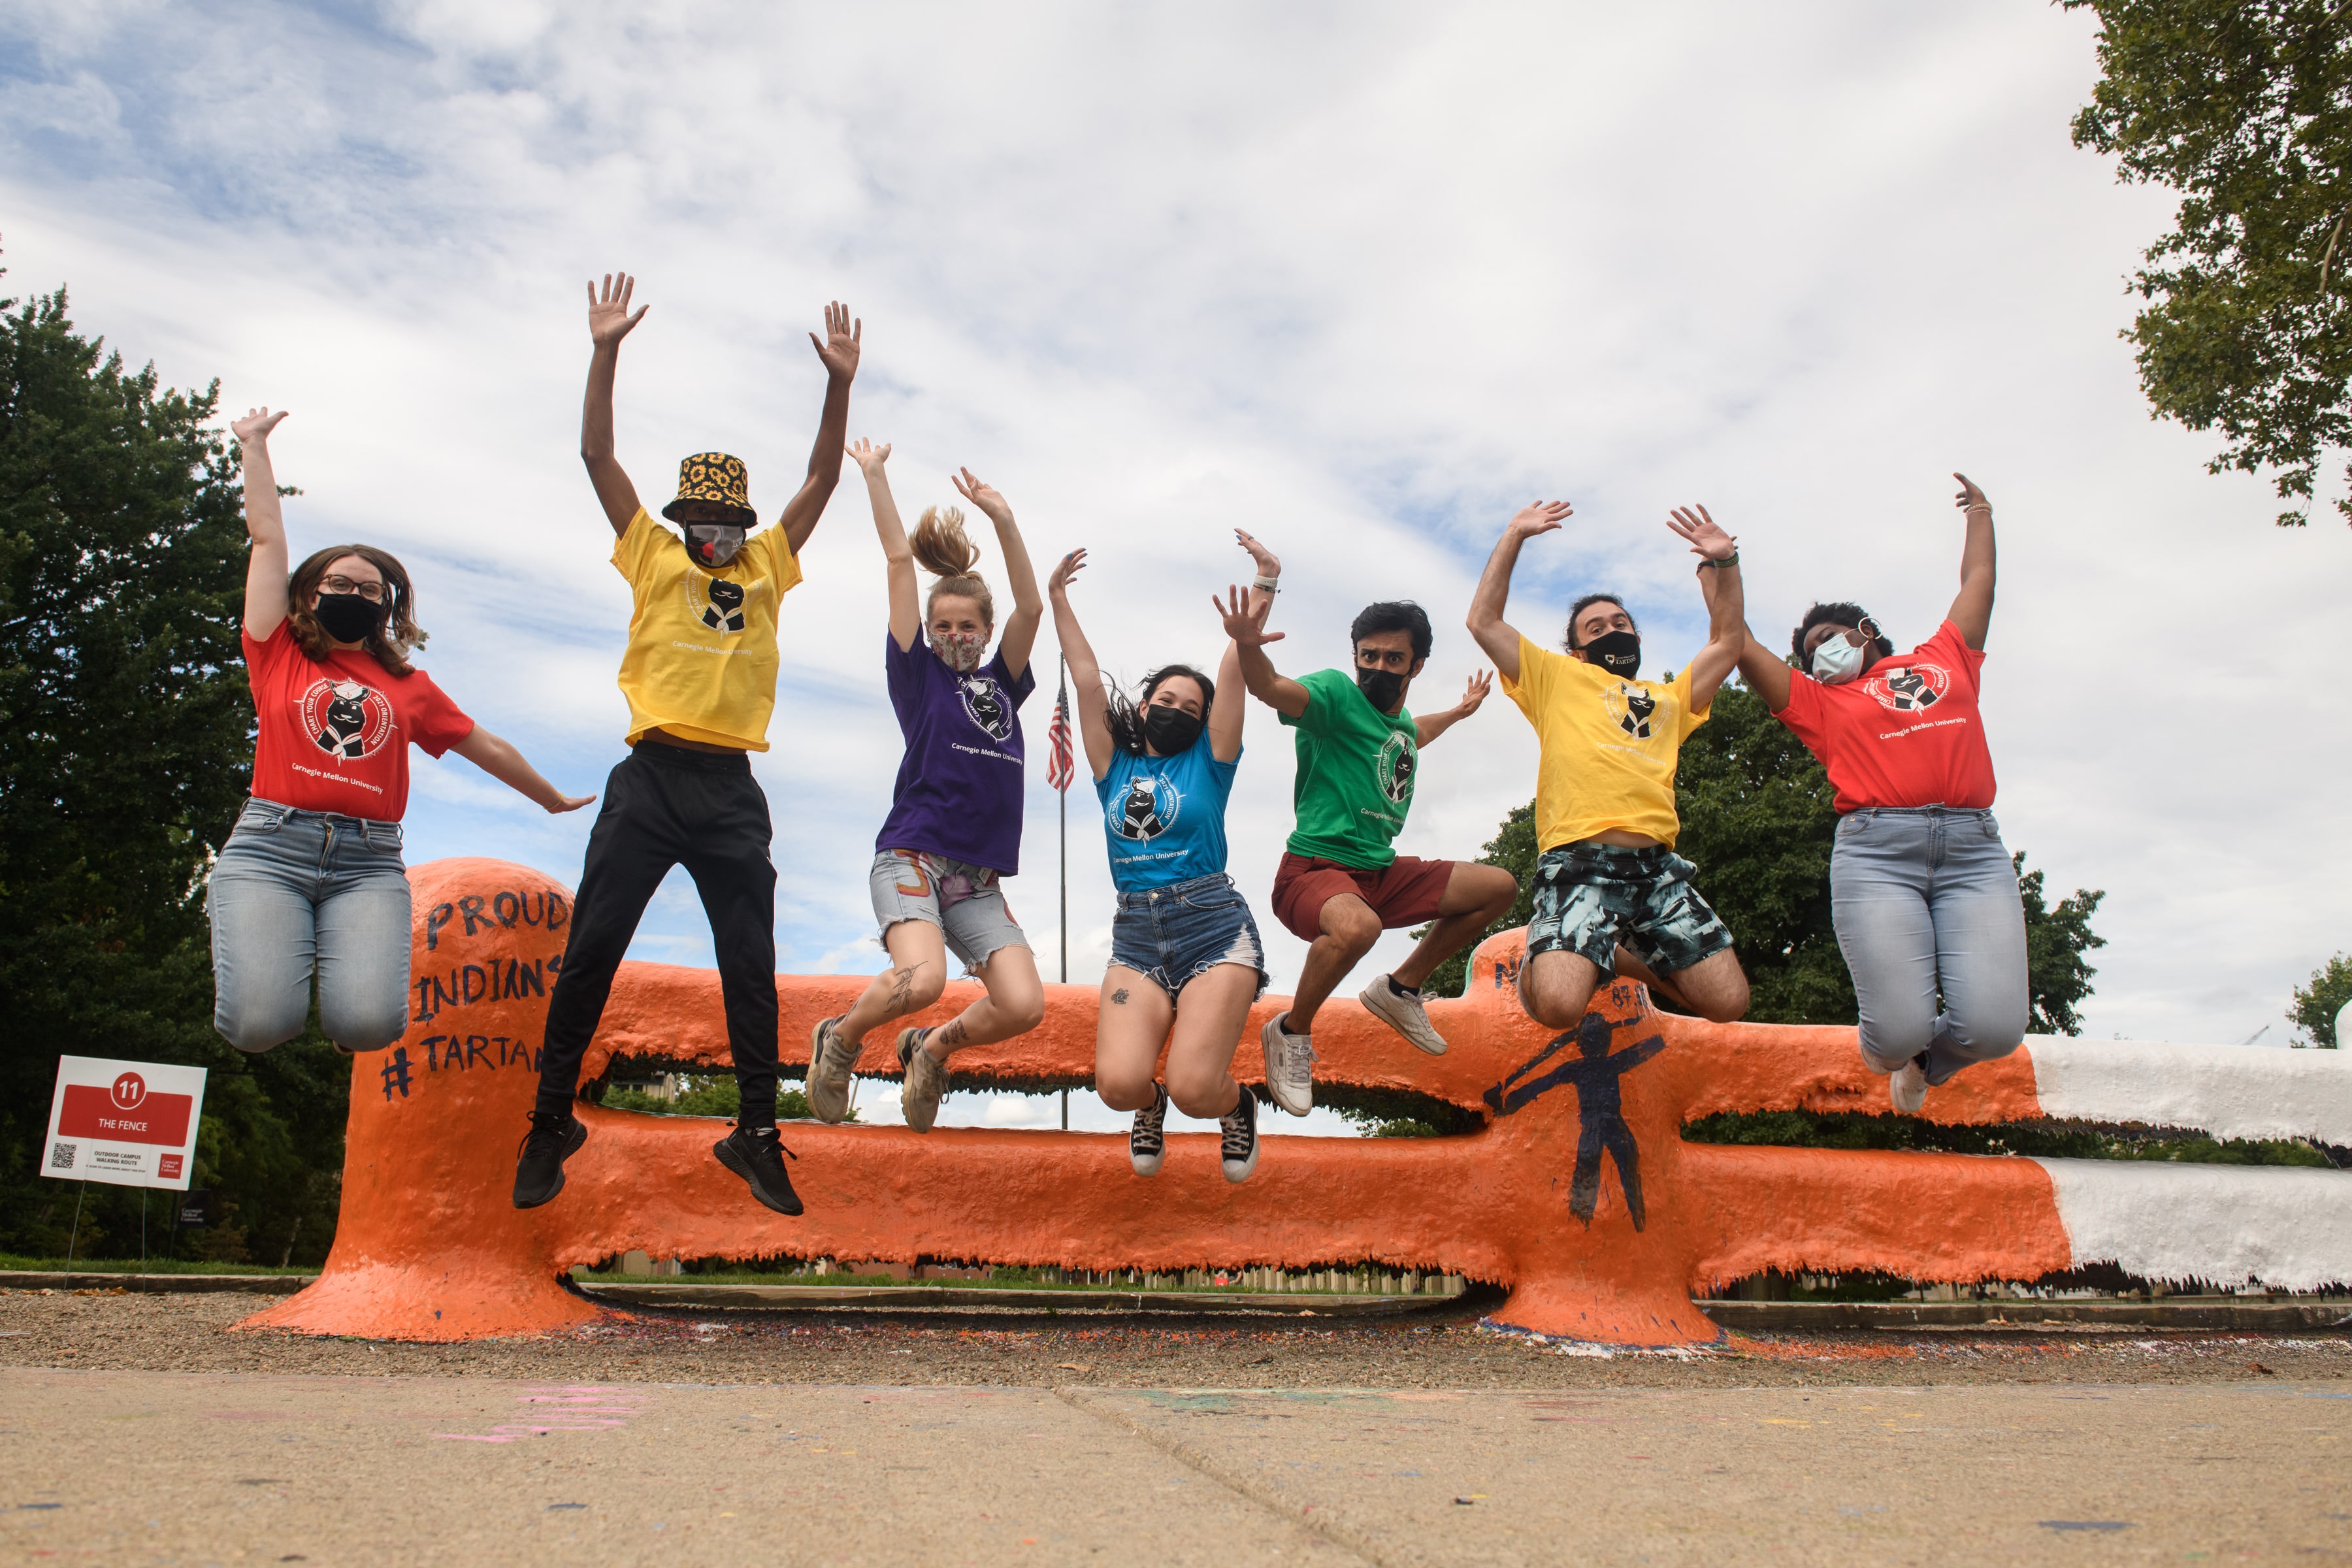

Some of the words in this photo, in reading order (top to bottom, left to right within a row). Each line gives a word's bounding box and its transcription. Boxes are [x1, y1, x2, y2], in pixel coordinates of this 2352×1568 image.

[692, 595, 703, 613] CHART
[673, 640, 703, 651] Carnegie
[705, 646, 727, 655] Mellon
[311, 683, 329, 697] COURSE
[306, 697, 315, 713] YOUR
[372, 695, 384, 708] 2021
[308, 716, 319, 734] CHART
[371, 708, 387, 746] ORIENTATION
[1880, 726, 1910, 740] Carnegie
[1910, 720, 1934, 732] Mellon
[1935, 717, 1966, 727] University
[1385, 738, 1397, 752] COURS
[1596, 742, 1624, 751] Carnegie
[1625, 746, 1642, 757] Mellon
[951, 743, 979, 754] Carnegie
[981, 749, 1001, 759] Mellon
[1002, 753, 1023, 766] University
[291, 762, 321, 777] Carnegie
[323, 772, 349, 783] Mellon
[350, 777, 384, 795] University
[1159, 778, 1169, 789] 2021
[1360, 808, 1384, 819] Carnegie
[1155, 849, 1189, 859] University
[427, 890, 568, 950] PROUD
[118, 1081, 139, 1100] 11
[99, 1118, 116, 1130] THE
[118, 1120, 148, 1132] FENCE
